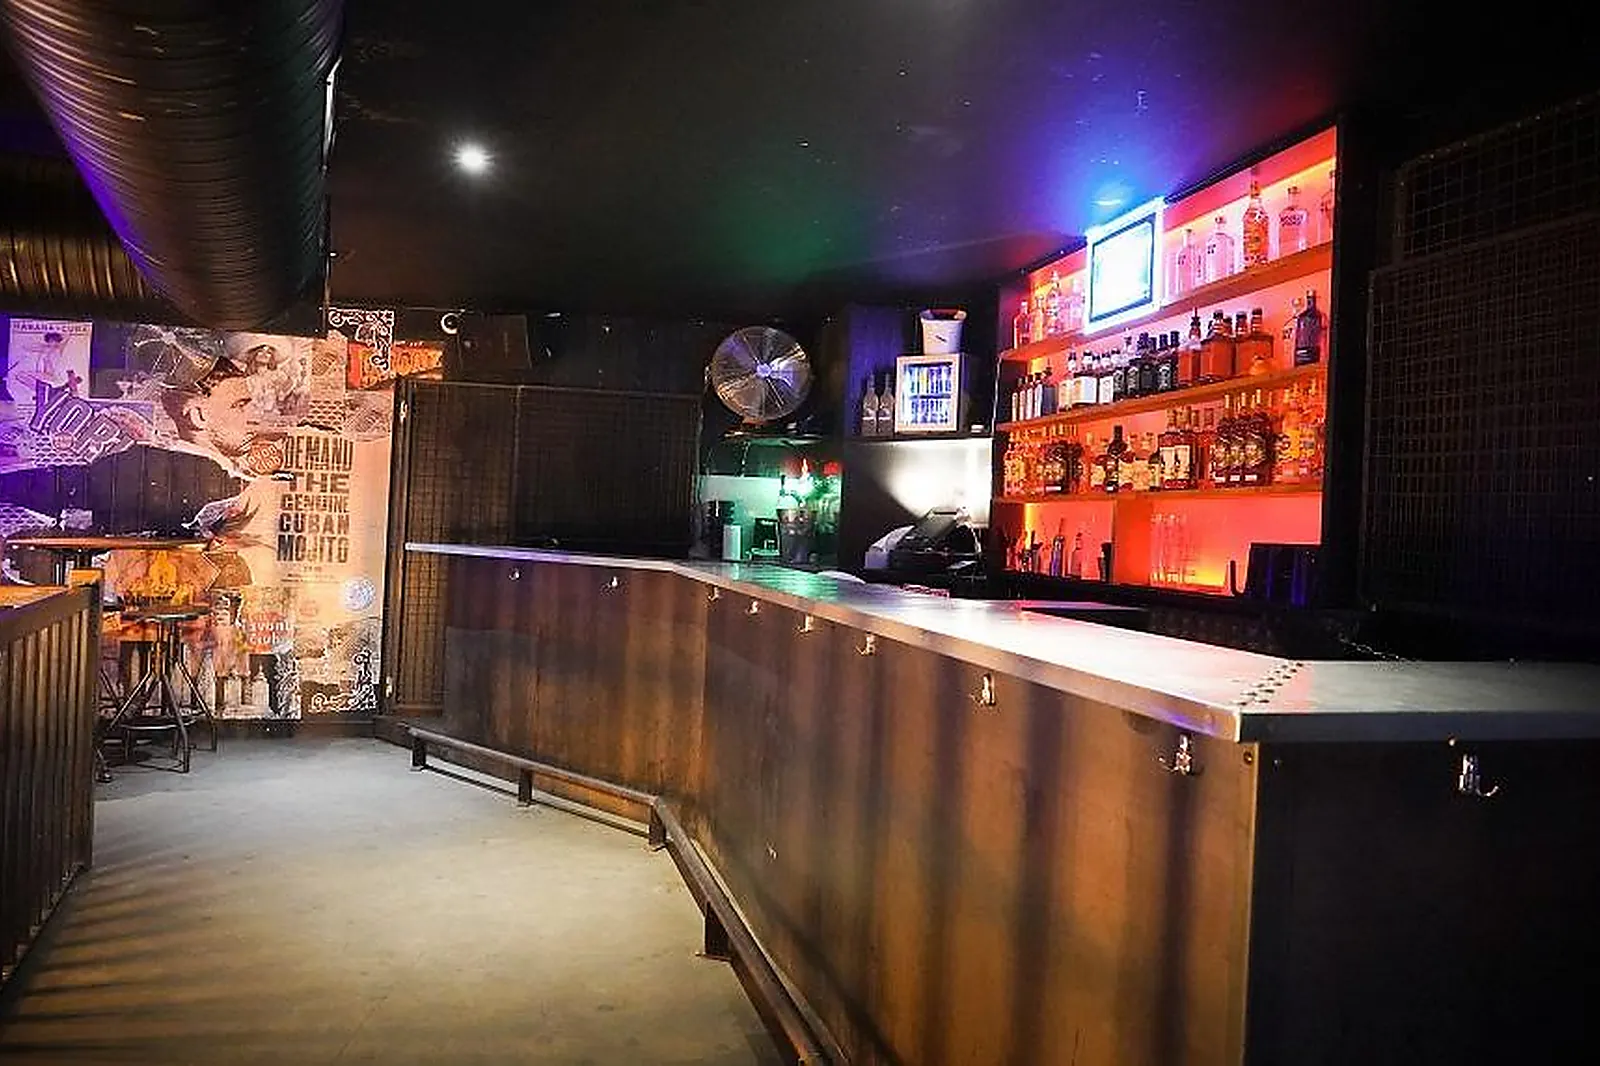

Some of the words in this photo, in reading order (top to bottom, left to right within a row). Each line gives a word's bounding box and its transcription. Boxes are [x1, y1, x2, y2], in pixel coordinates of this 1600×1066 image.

[284, 435, 354, 472] DEMAND
[287, 471, 350, 494] THE
[281, 494, 350, 513] GENUINE
[279, 513, 350, 535] CUBAN
[277, 535, 348, 563] MOJITO
